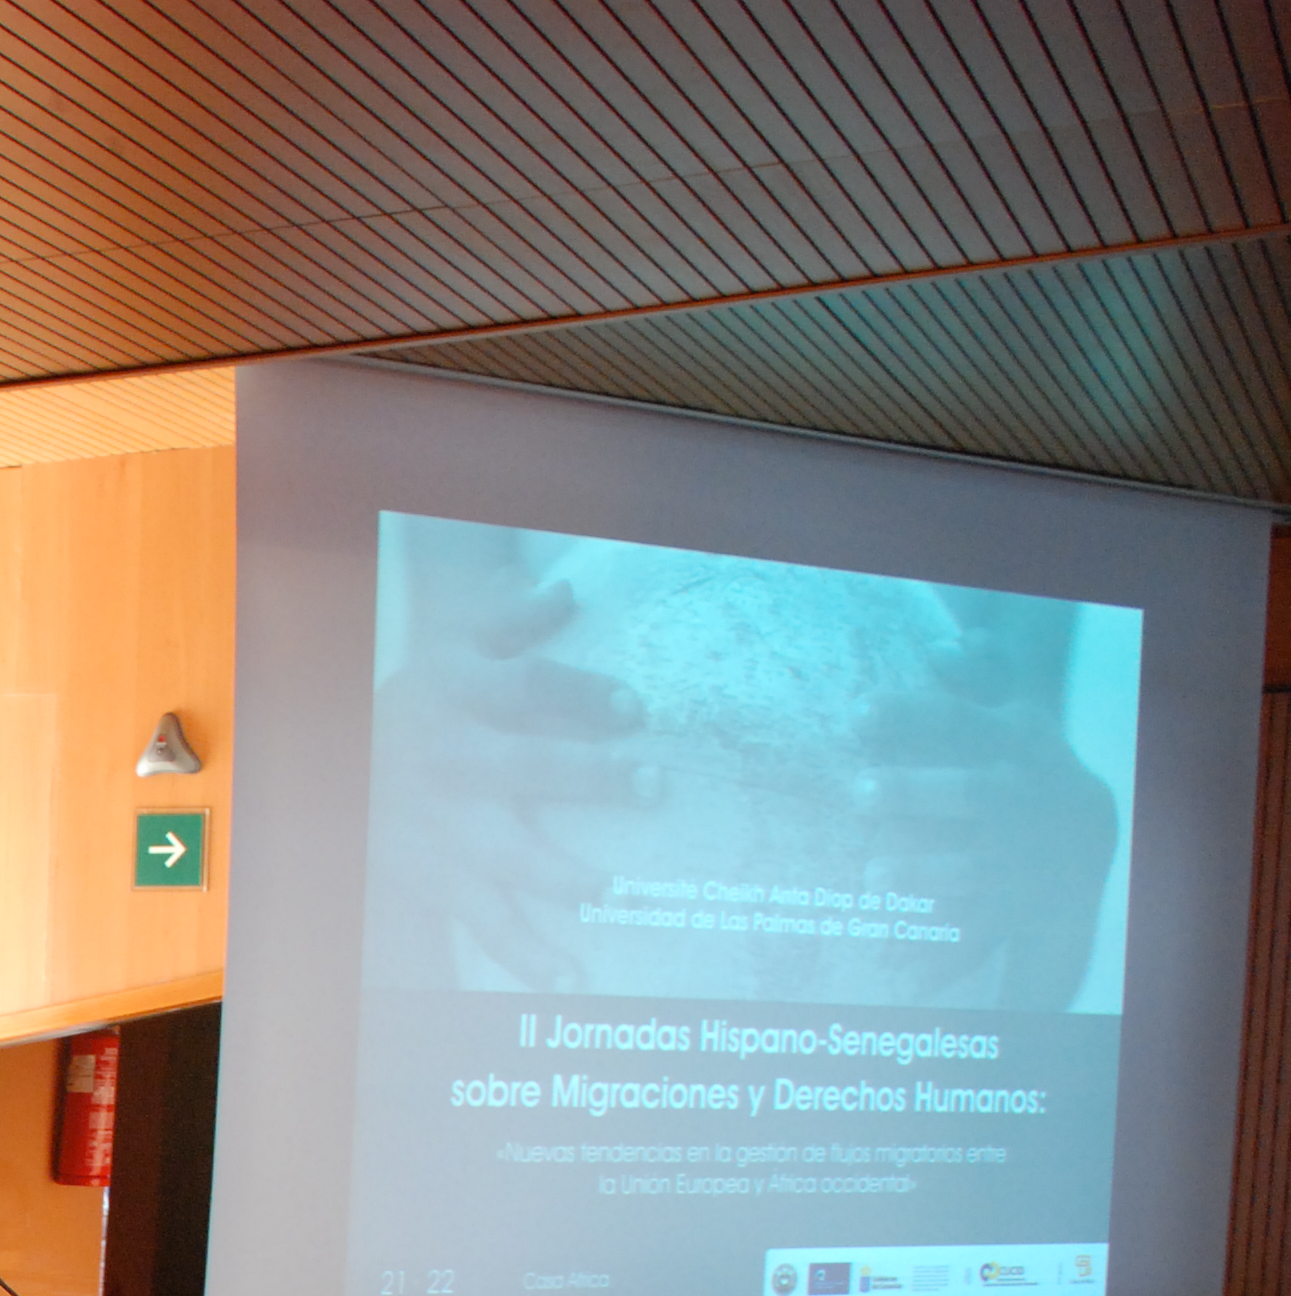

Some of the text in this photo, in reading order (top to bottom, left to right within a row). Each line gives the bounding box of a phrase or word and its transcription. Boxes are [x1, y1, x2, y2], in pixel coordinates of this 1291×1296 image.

[703, 880, 764, 903] Cheikh
[769, 884, 809, 906] Anta
[814, 887, 854, 911] Diop
[858, 891, 881, 911] de
[886, 892, 935, 914] Dakar
[580, 903, 961, 943] Universidad de Las Palmas de Gran Canaria
[519, 1013, 1000, 1065] II Jornadas Hispano-Senegalesas
[450, 1073, 1047, 1117] sobre Migraciones y Derechos Humanos:
[581, 1142, 682, 1163] tendencias
[687, 1146, 710, 1163] en
[715, 1143, 732, 1163] la
[802, 1143, 826, 1163] de
[830, 1142, 870, 1166] flujos
[875, 1143, 963, 1167] migratorios
[966, 1145, 1007, 1163] entre
[598, 1174, 616, 1194] la
[676, 1173, 749, 1197] Europea
[755, 1178, 765, 1196] y
[380, 1269, 455, 1295] 21 22
